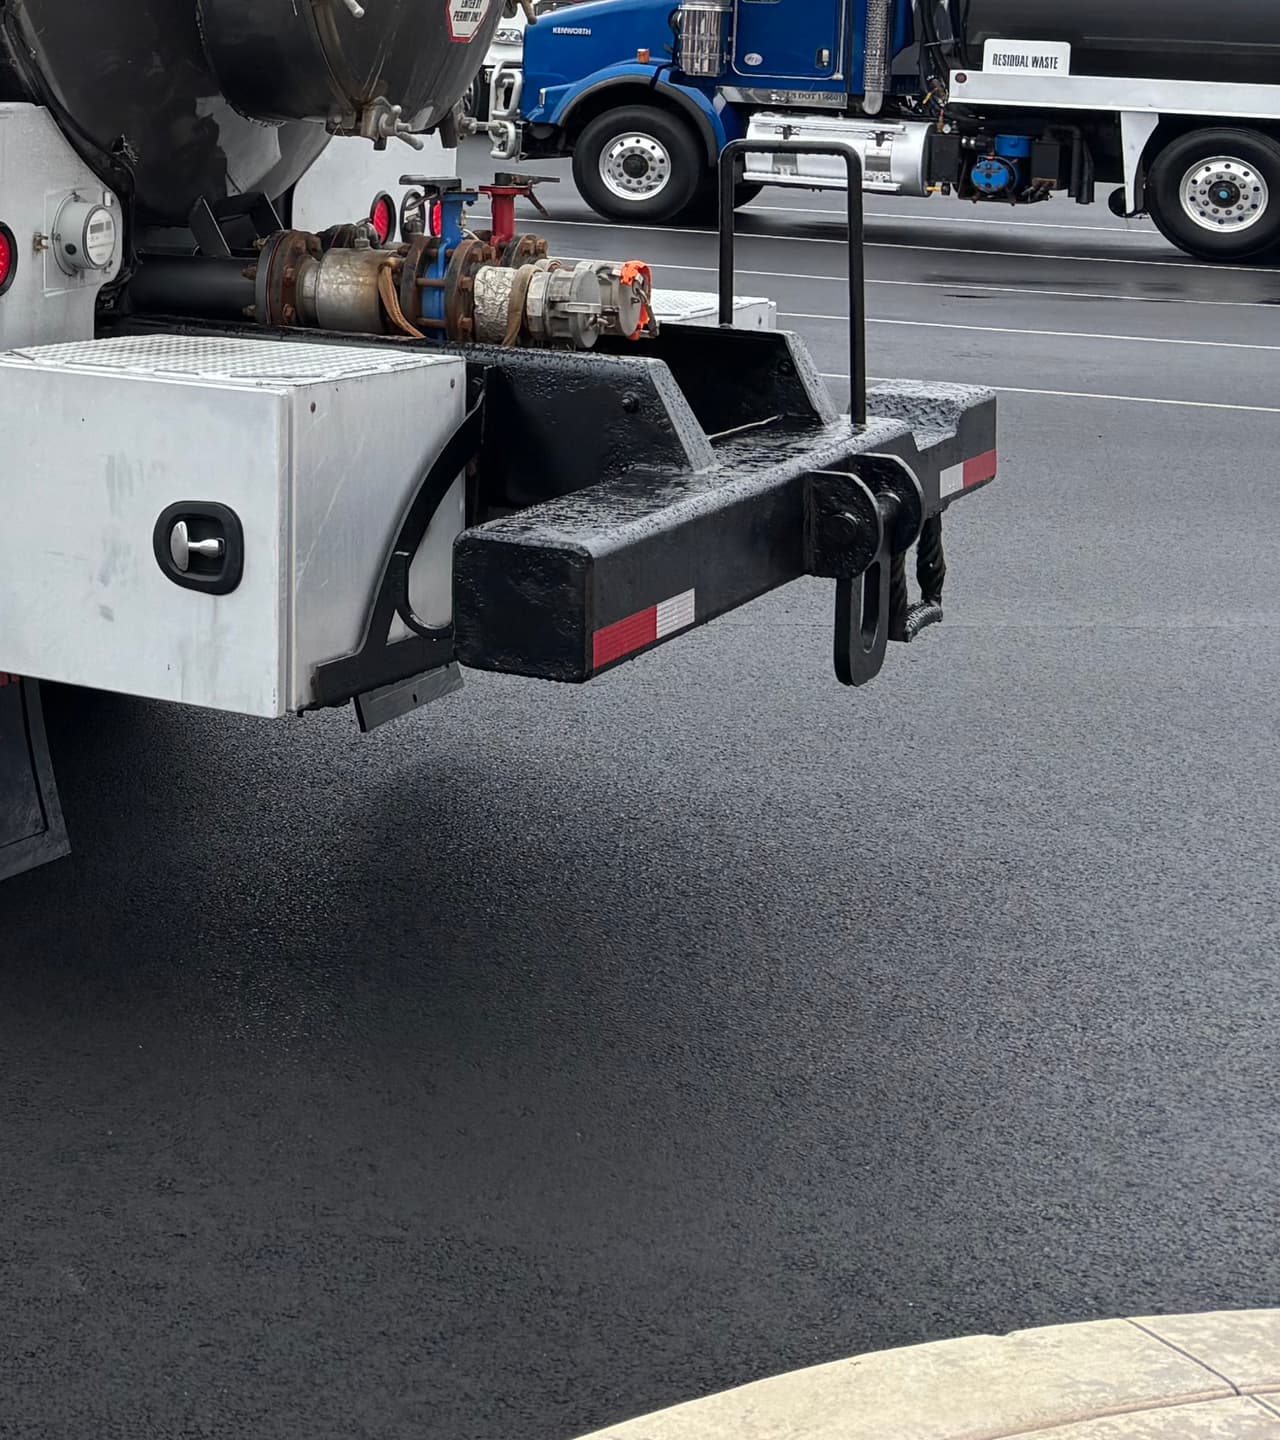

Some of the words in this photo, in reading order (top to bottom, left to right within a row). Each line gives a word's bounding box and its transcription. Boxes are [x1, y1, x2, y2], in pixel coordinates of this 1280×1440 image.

[552, 26, 592, 36] KENWORTH
[992, 53, 1028, 68] RESIDUAL
[1031, 55, 1059, 70] WASTE
